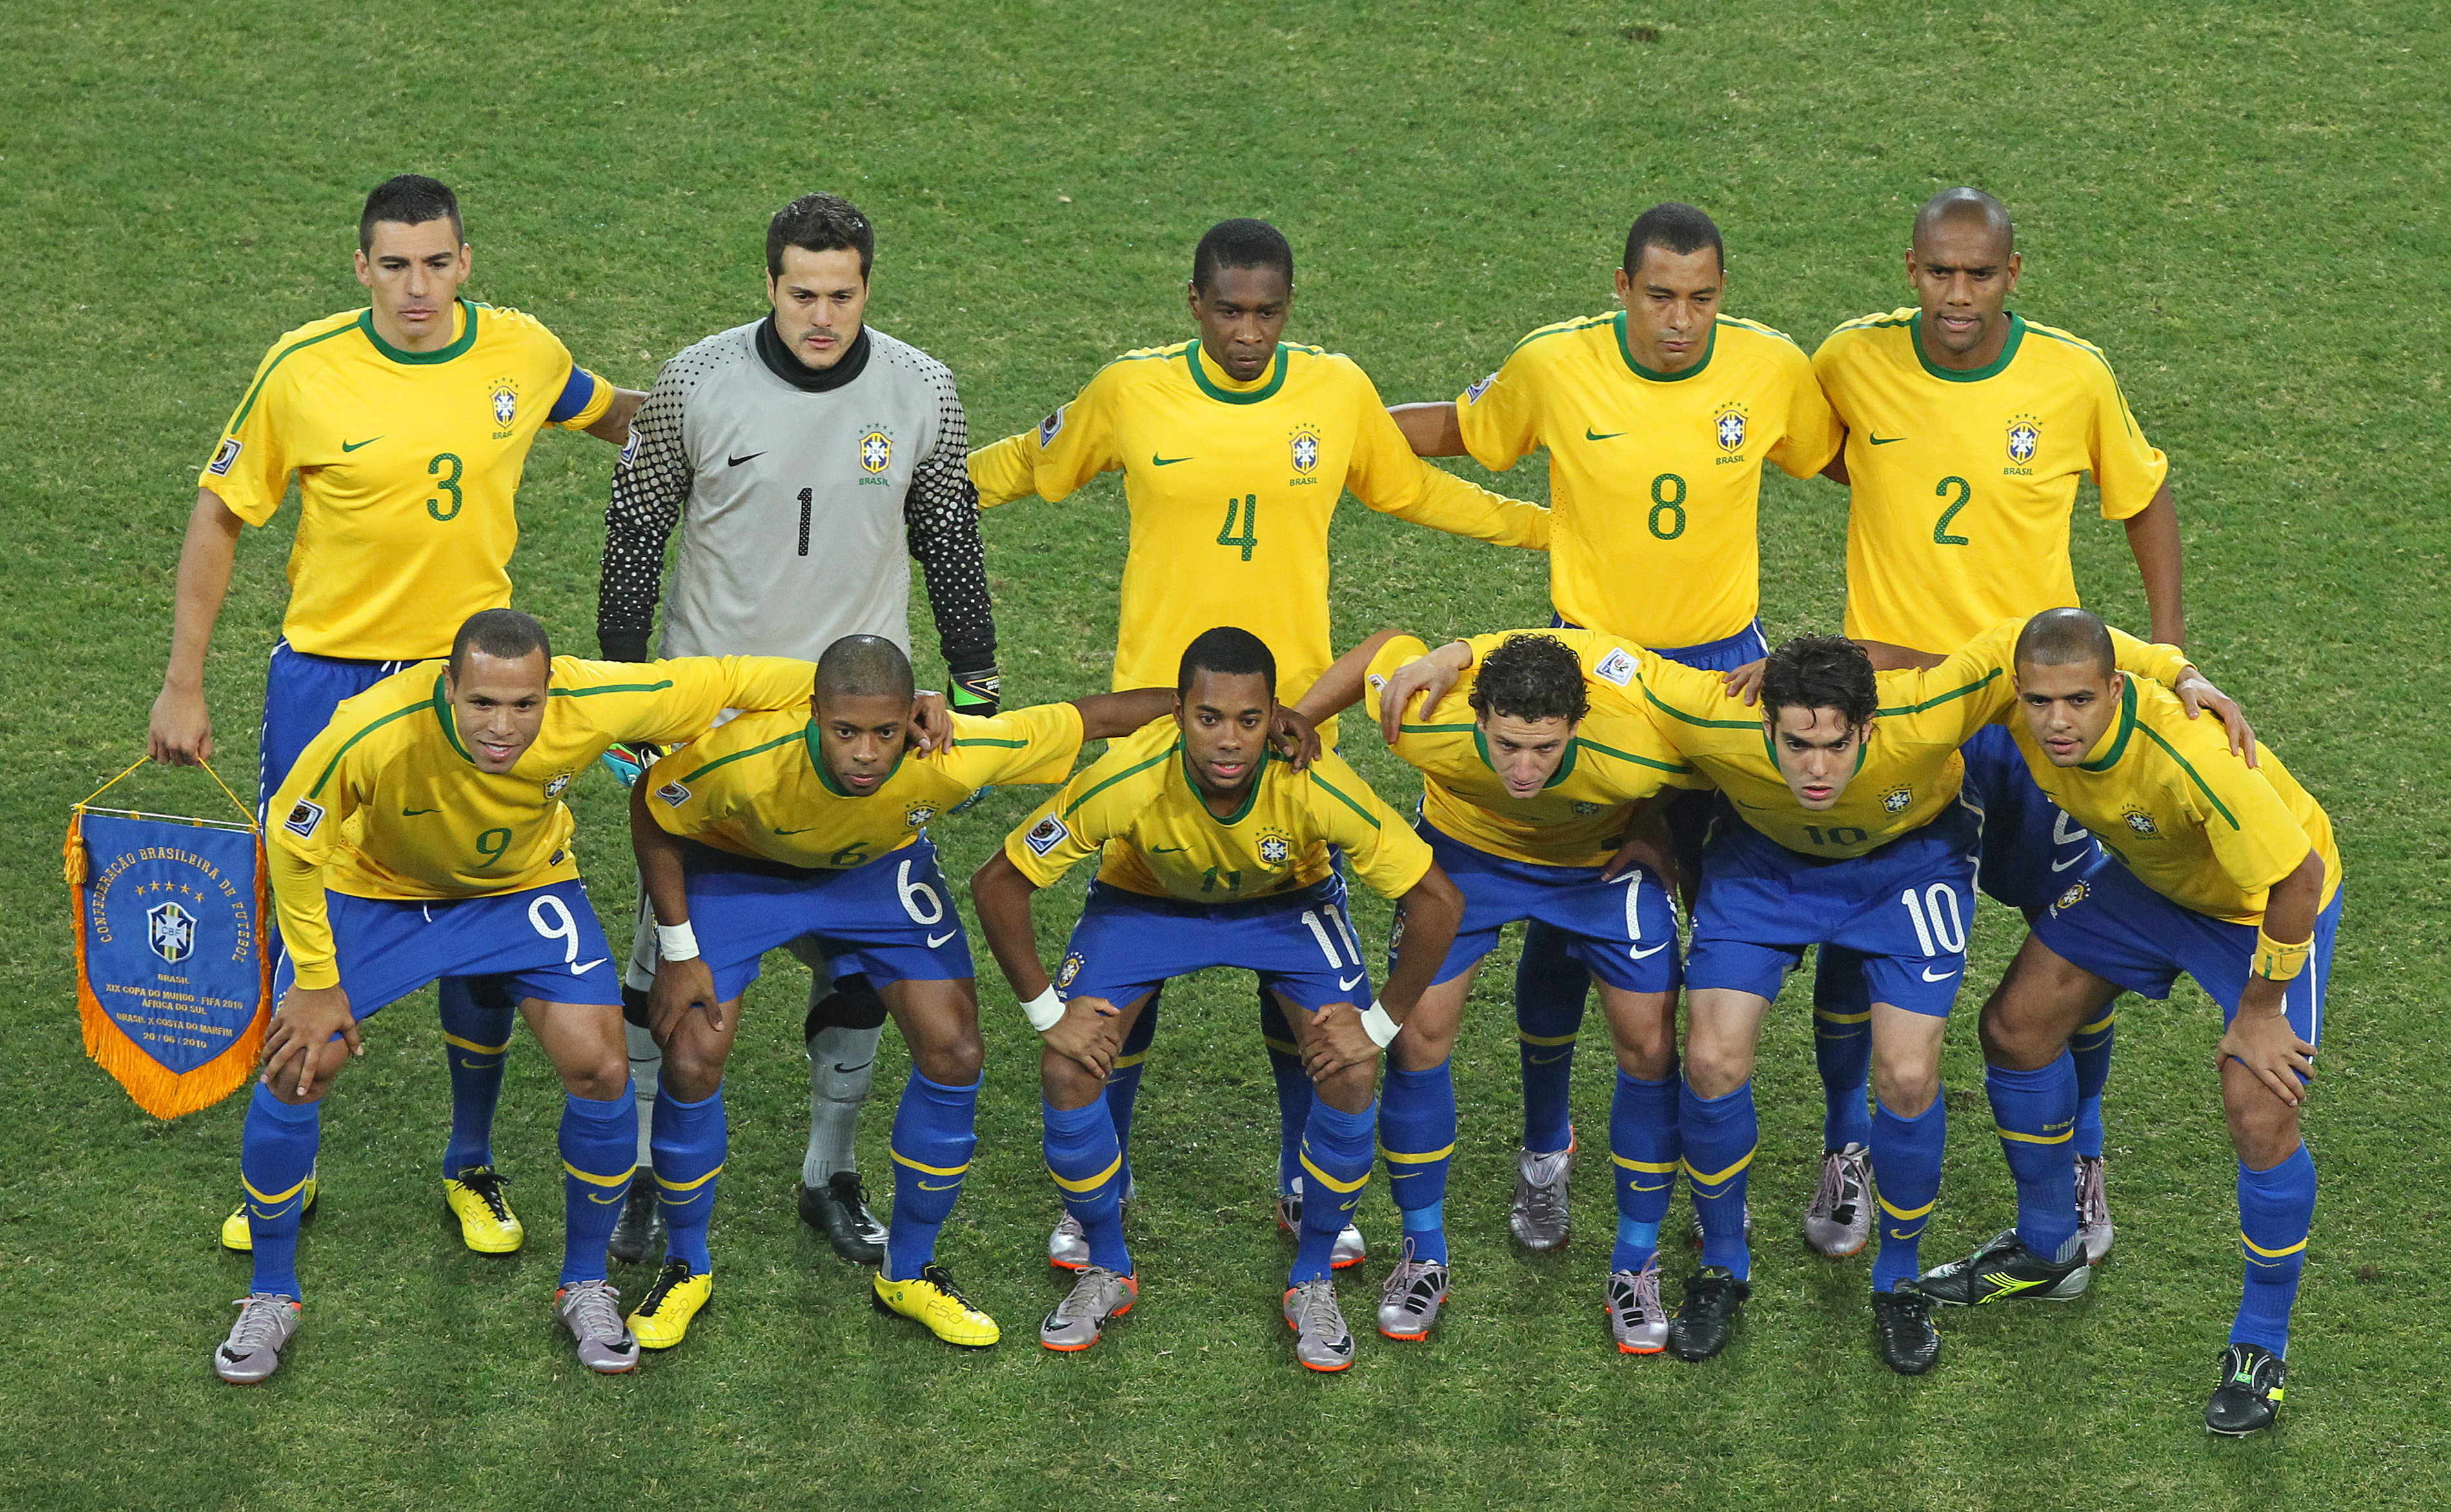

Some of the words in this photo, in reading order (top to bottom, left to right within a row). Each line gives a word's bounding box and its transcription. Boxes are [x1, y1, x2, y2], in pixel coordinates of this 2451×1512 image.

[1715, 454, 1745, 465] BRASIL
[2003, 467, 2033, 476] BRASIL
[427, 453, 463, 521] 3
[859, 478, 890, 487] BRASIL
[1289, 476, 1318, 487] BRASIL
[1648, 473, 1686, 540] 8
[1933, 476, 1971, 545] 2
[797, 488, 812, 556] 1
[1217, 494, 1258, 561] 4
[476, 827, 512, 868] 9
[1802, 825, 1868, 846] 10
[830, 842, 869, 865] 6
[897, 859, 943, 925] 6
[1201, 865, 1241, 894] 11
[92, 852, 137, 943] CONFEDERAÇÃO
[139, 847, 221, 880] BRASILEIRA
[218, 878, 237, 898] DE
[231, 902, 250, 963] FUTEBOL
[1608, 869, 1642, 941] 7
[161, 926, 181, 936] CBF
[528, 894, 580, 963] 9
[1901, 882, 1966, 958] 10
[1301, 904, 1361, 969] 11
[157, 973, 191, 984] BRASIL
[106, 983, 121, 993] XIX
[123, 986, 146, 996] COPA
[148, 989, 161, 998] DO
[163, 991, 194, 1002] MUNDO
[201, 996, 221, 1007] FIFA
[223, 1000, 243, 1009] 2010
[142, 998, 174, 1011] ÁFRICA
[190, 1005, 207, 1015] SUL
[116, 1013, 146, 1024] BRASIL
[156, 1017, 184, 1029] COSTA
[186, 1022, 198, 1031] DO
[200, 1024, 233, 1037] MARFIM
[143, 1032, 156, 1041] 20
[163, 1034, 176, 1043] 06
[183, 1038, 207, 1049] 2010
[664, 1298, 690, 1326] F50
[925, 1300, 963, 1325] F50
